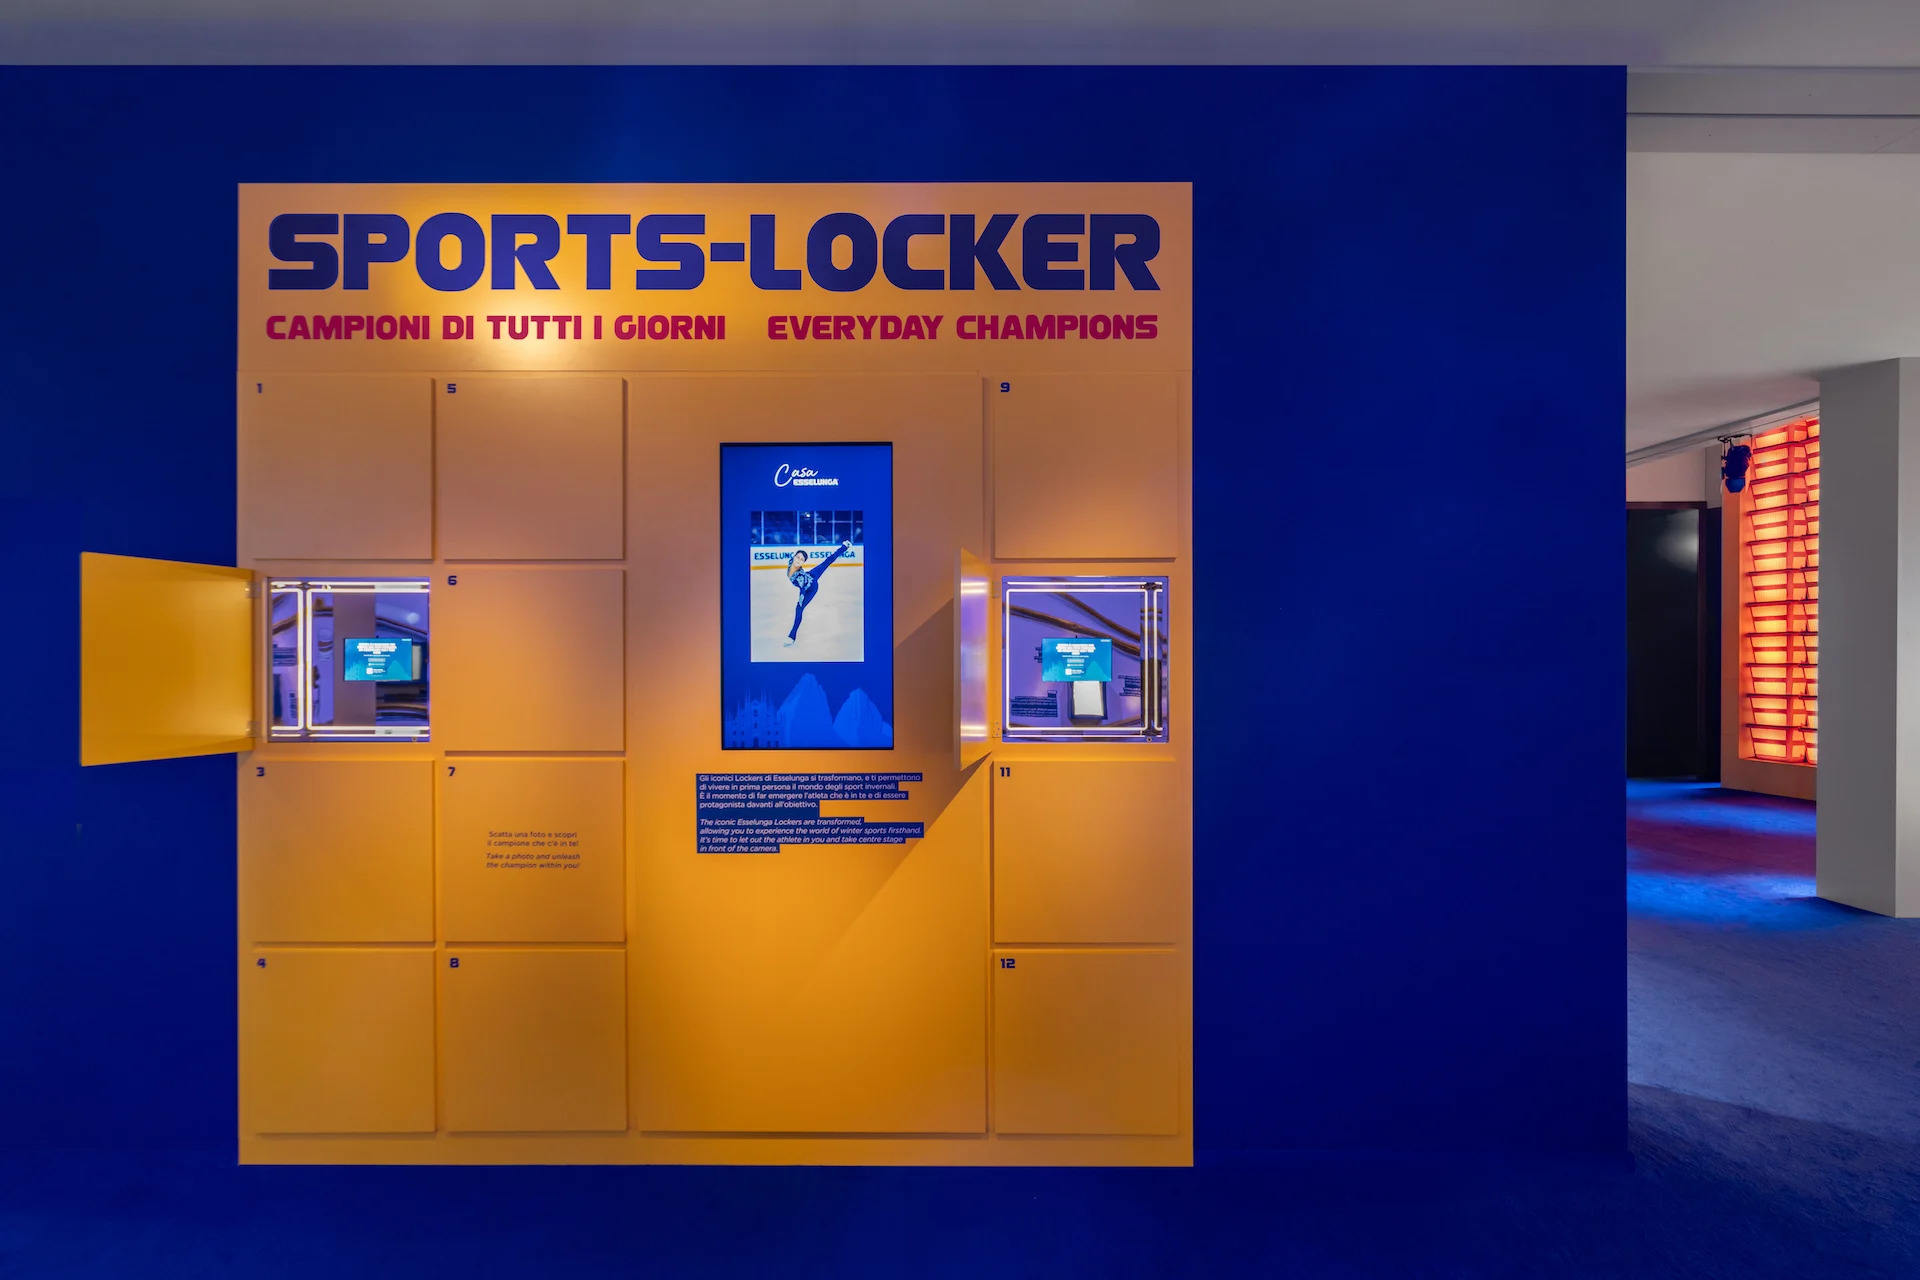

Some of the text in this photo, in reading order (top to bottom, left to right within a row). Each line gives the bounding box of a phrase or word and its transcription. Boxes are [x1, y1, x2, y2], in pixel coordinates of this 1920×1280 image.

[268, 212, 1161, 292] SPORTS-LOCKER
[266, 314, 726, 341] CAMPIONI DI TUTTI I GIORNI
[767, 314, 1158, 341] EVERYDAY CHAMPIONS
[256, 383, 262, 394] 1
[447, 384, 456, 394] 5
[1000, 382, 1011, 393] 9
[774, 464, 818, 487] Casa
[793, 478, 838, 486] ESSELUNGA
[448, 576, 458, 586] 6
[256, 767, 265, 776] 3
[448, 766, 456, 776] 7
[1000, 766, 1011, 777] 11
[740, 784, 760, 792] prima
[737, 819, 772, 827] Esselunga
[700, 828, 729, 836] allowing
[756, 828, 794, 836] experience
[257, 958, 266, 968] 4
[450, 958, 460, 968] 8
[1000, 958, 1016, 968] 12
